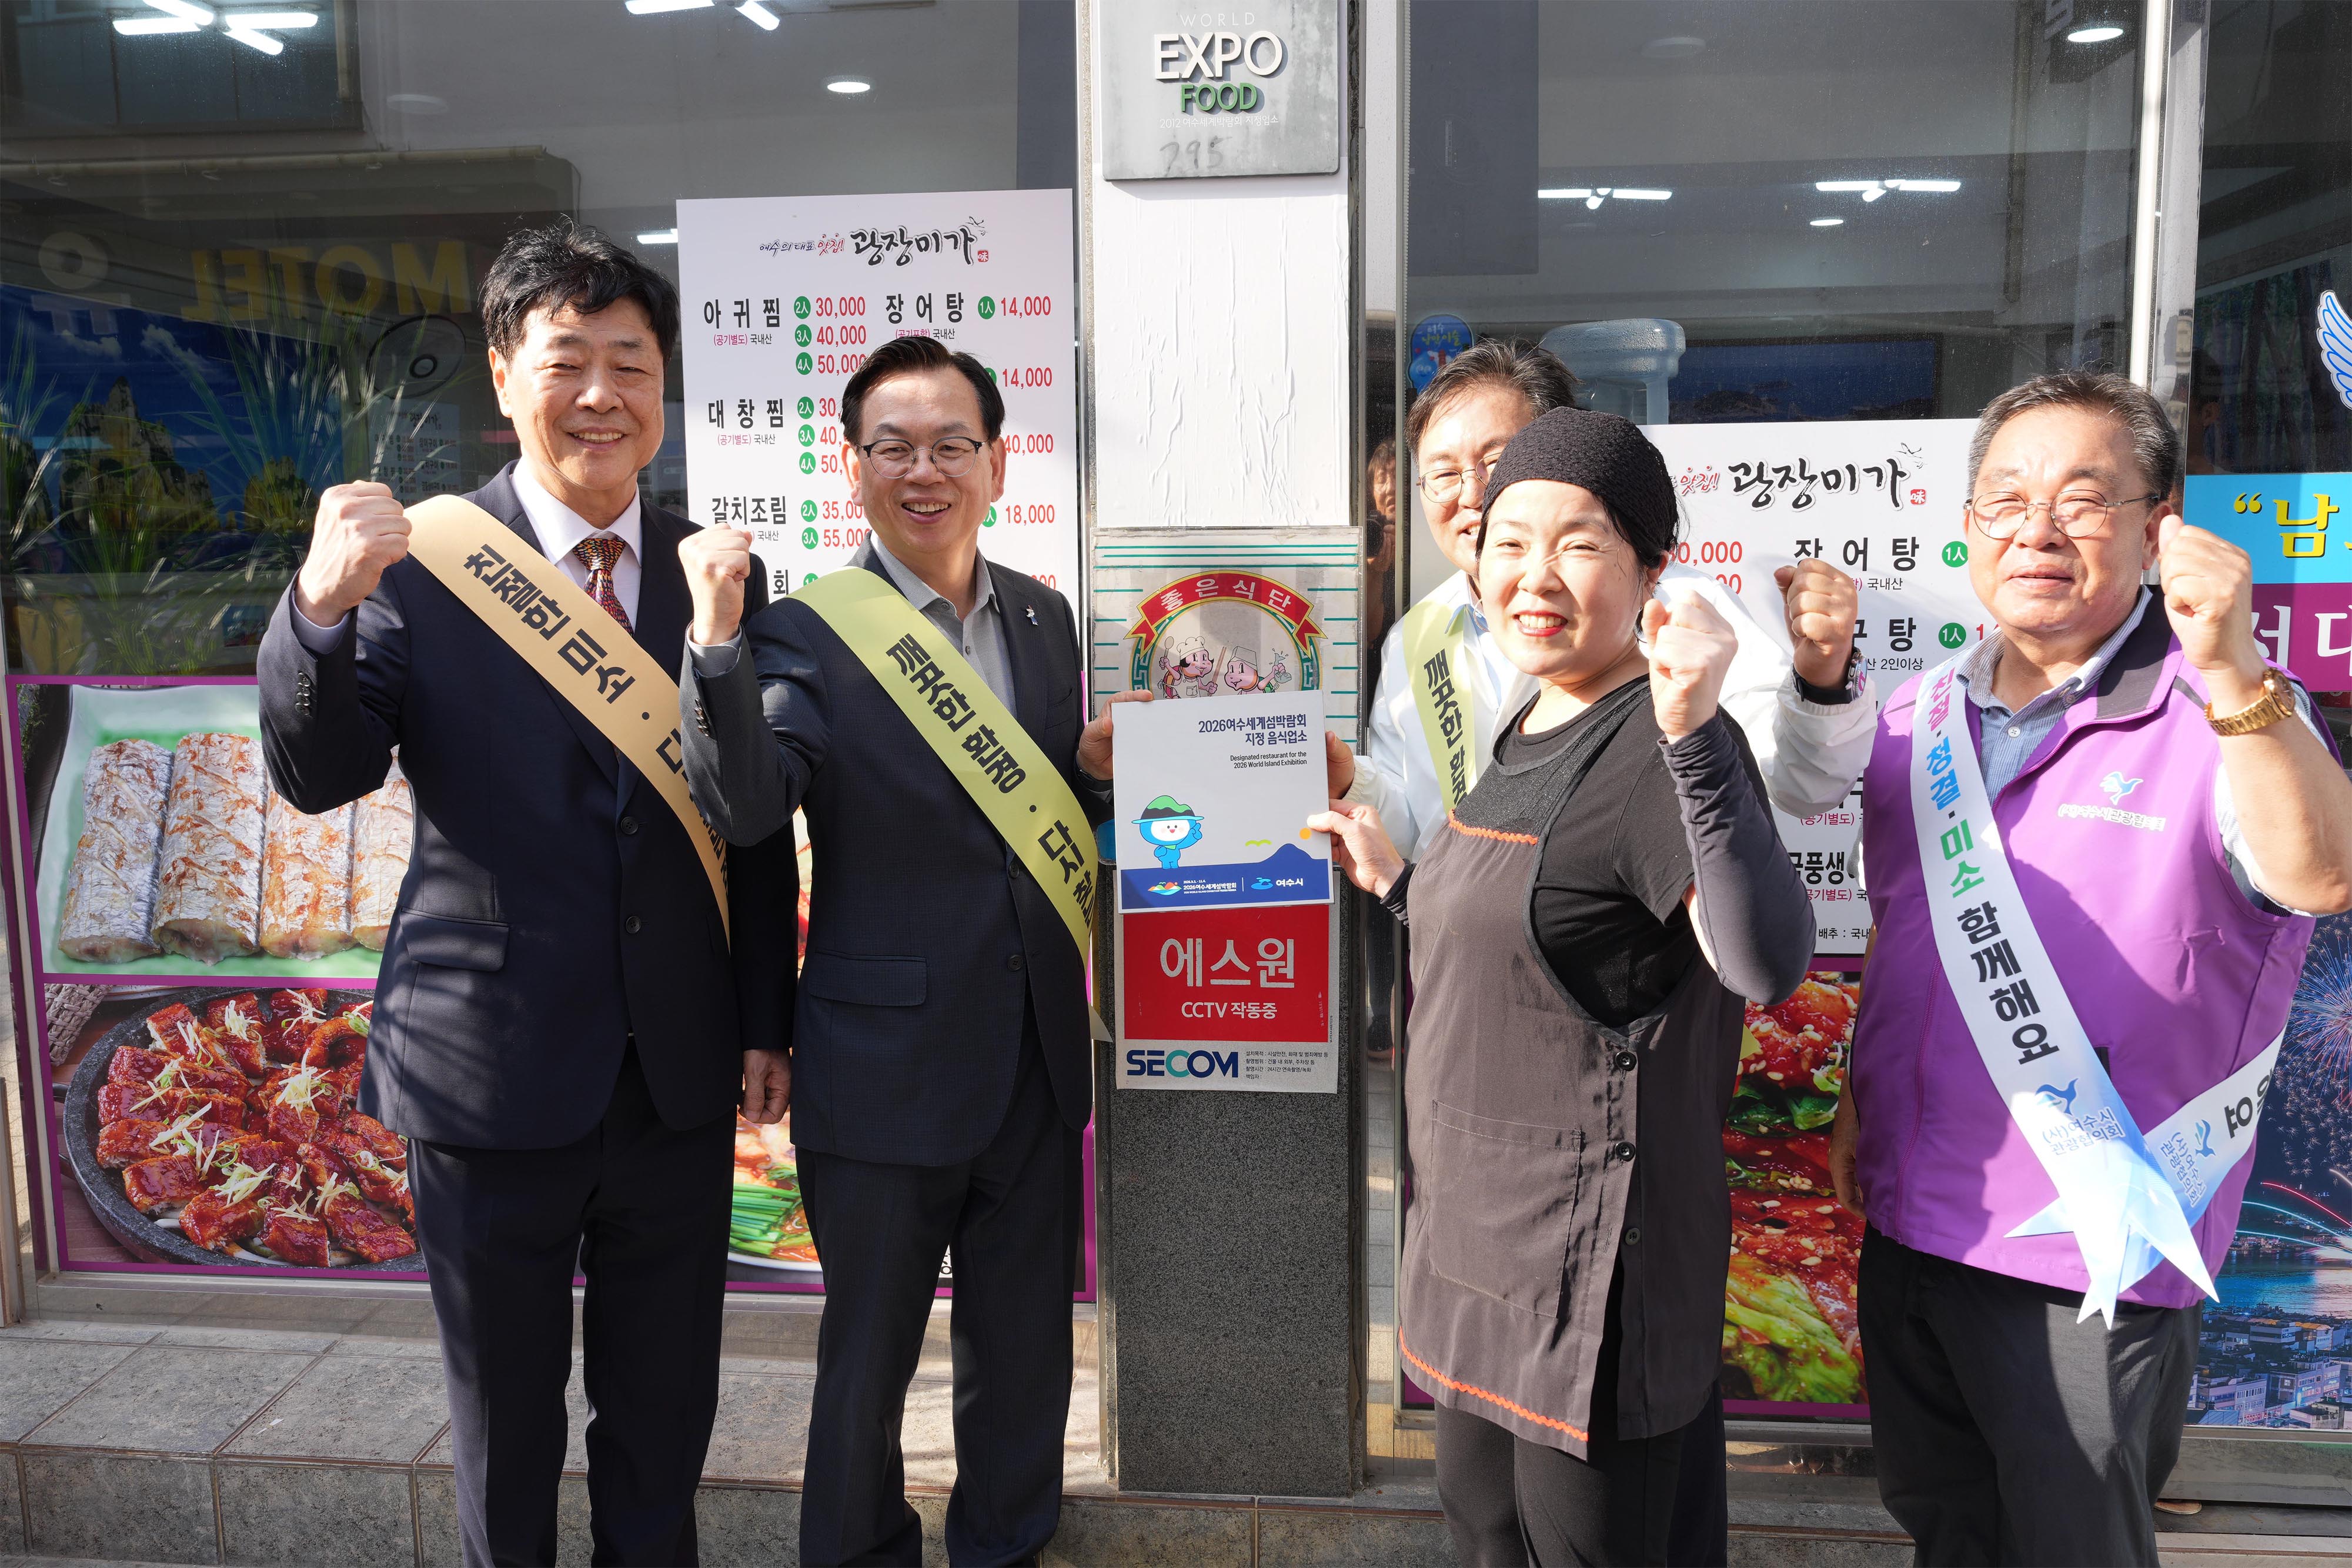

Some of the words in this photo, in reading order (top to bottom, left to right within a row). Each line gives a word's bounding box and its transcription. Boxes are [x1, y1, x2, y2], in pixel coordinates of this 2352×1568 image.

[1180, 12, 1255, 27] WORLD
[1154, 30, 1283, 80] EXPO
[1181, 82, 1258, 112] FOOD
[1160, 118, 1181, 128] 2012
[1183, 117, 1242, 128] 여수세계박람회
[1245, 115, 1279, 126] 지정업소
[794, 240, 816, 252] 대표
[850, 226, 977, 266] 광장미가
[816, 296, 866, 318] 30,000
[1001, 296, 1051, 318] 14,000
[713, 334, 748, 346] (공기별도)
[750, 333, 772, 345] 국내산
[817, 325, 866, 347] 40,000
[933, 328, 956, 339] 국내산
[1002, 367, 1053, 389] 14,000
[717, 434, 751, 446] (공기별도)
[754, 434, 776, 445] 국내산
[1728, 457, 1911, 509] 광장미가
[711, 496, 787, 526] 갈치조림
[823, 500, 867, 521] 35,00
[1005, 504, 1055, 526] 18,000
[757, 530, 779, 541] 국내산
[824, 528, 870, 550] 55,00
[1867, 577, 1903, 590] 국내산
[462, 544, 571, 640] 친절한
[557, 628, 636, 704] 미소
[1881, 658, 1924, 671] 2인이상
[1424, 648, 1463, 749] 깨끗한
[1198, 713, 1307, 733] 2026여수세계섬박람회
[1245, 733, 1265, 746] 지정
[1268, 730, 1307, 745] 음식업소
[886, 633, 977, 733] 깨끗한
[961, 724, 1026, 794] 환경
[1037, 820, 1085, 884] 다시
[1800, 813, 1855, 825] (공기별도)
[1940, 819, 1985, 898] 미소
[1275, 878, 1304, 887] 여수시
[1806, 889, 1852, 901] 공기별도)
[1819, 928, 1838, 939] 배추
[1850, 928, 1869, 940] 국내
[1160, 938, 1295, 988] 에스원
[1957, 901, 2060, 1065] 함께해요
[1181, 1002, 1227, 1018] CCTV
[1231, 1002, 1277, 1019] 작동중
[1127, 1049, 1238, 1078] SECOM
[2043, 1108, 2115, 1144] (사)여수시
[2050, 1123, 2123, 1155] 관광협의회
[2160, 1141, 2200, 1207] 관광협의회
[2171, 1132, 2206, 1196] (사)여수시
